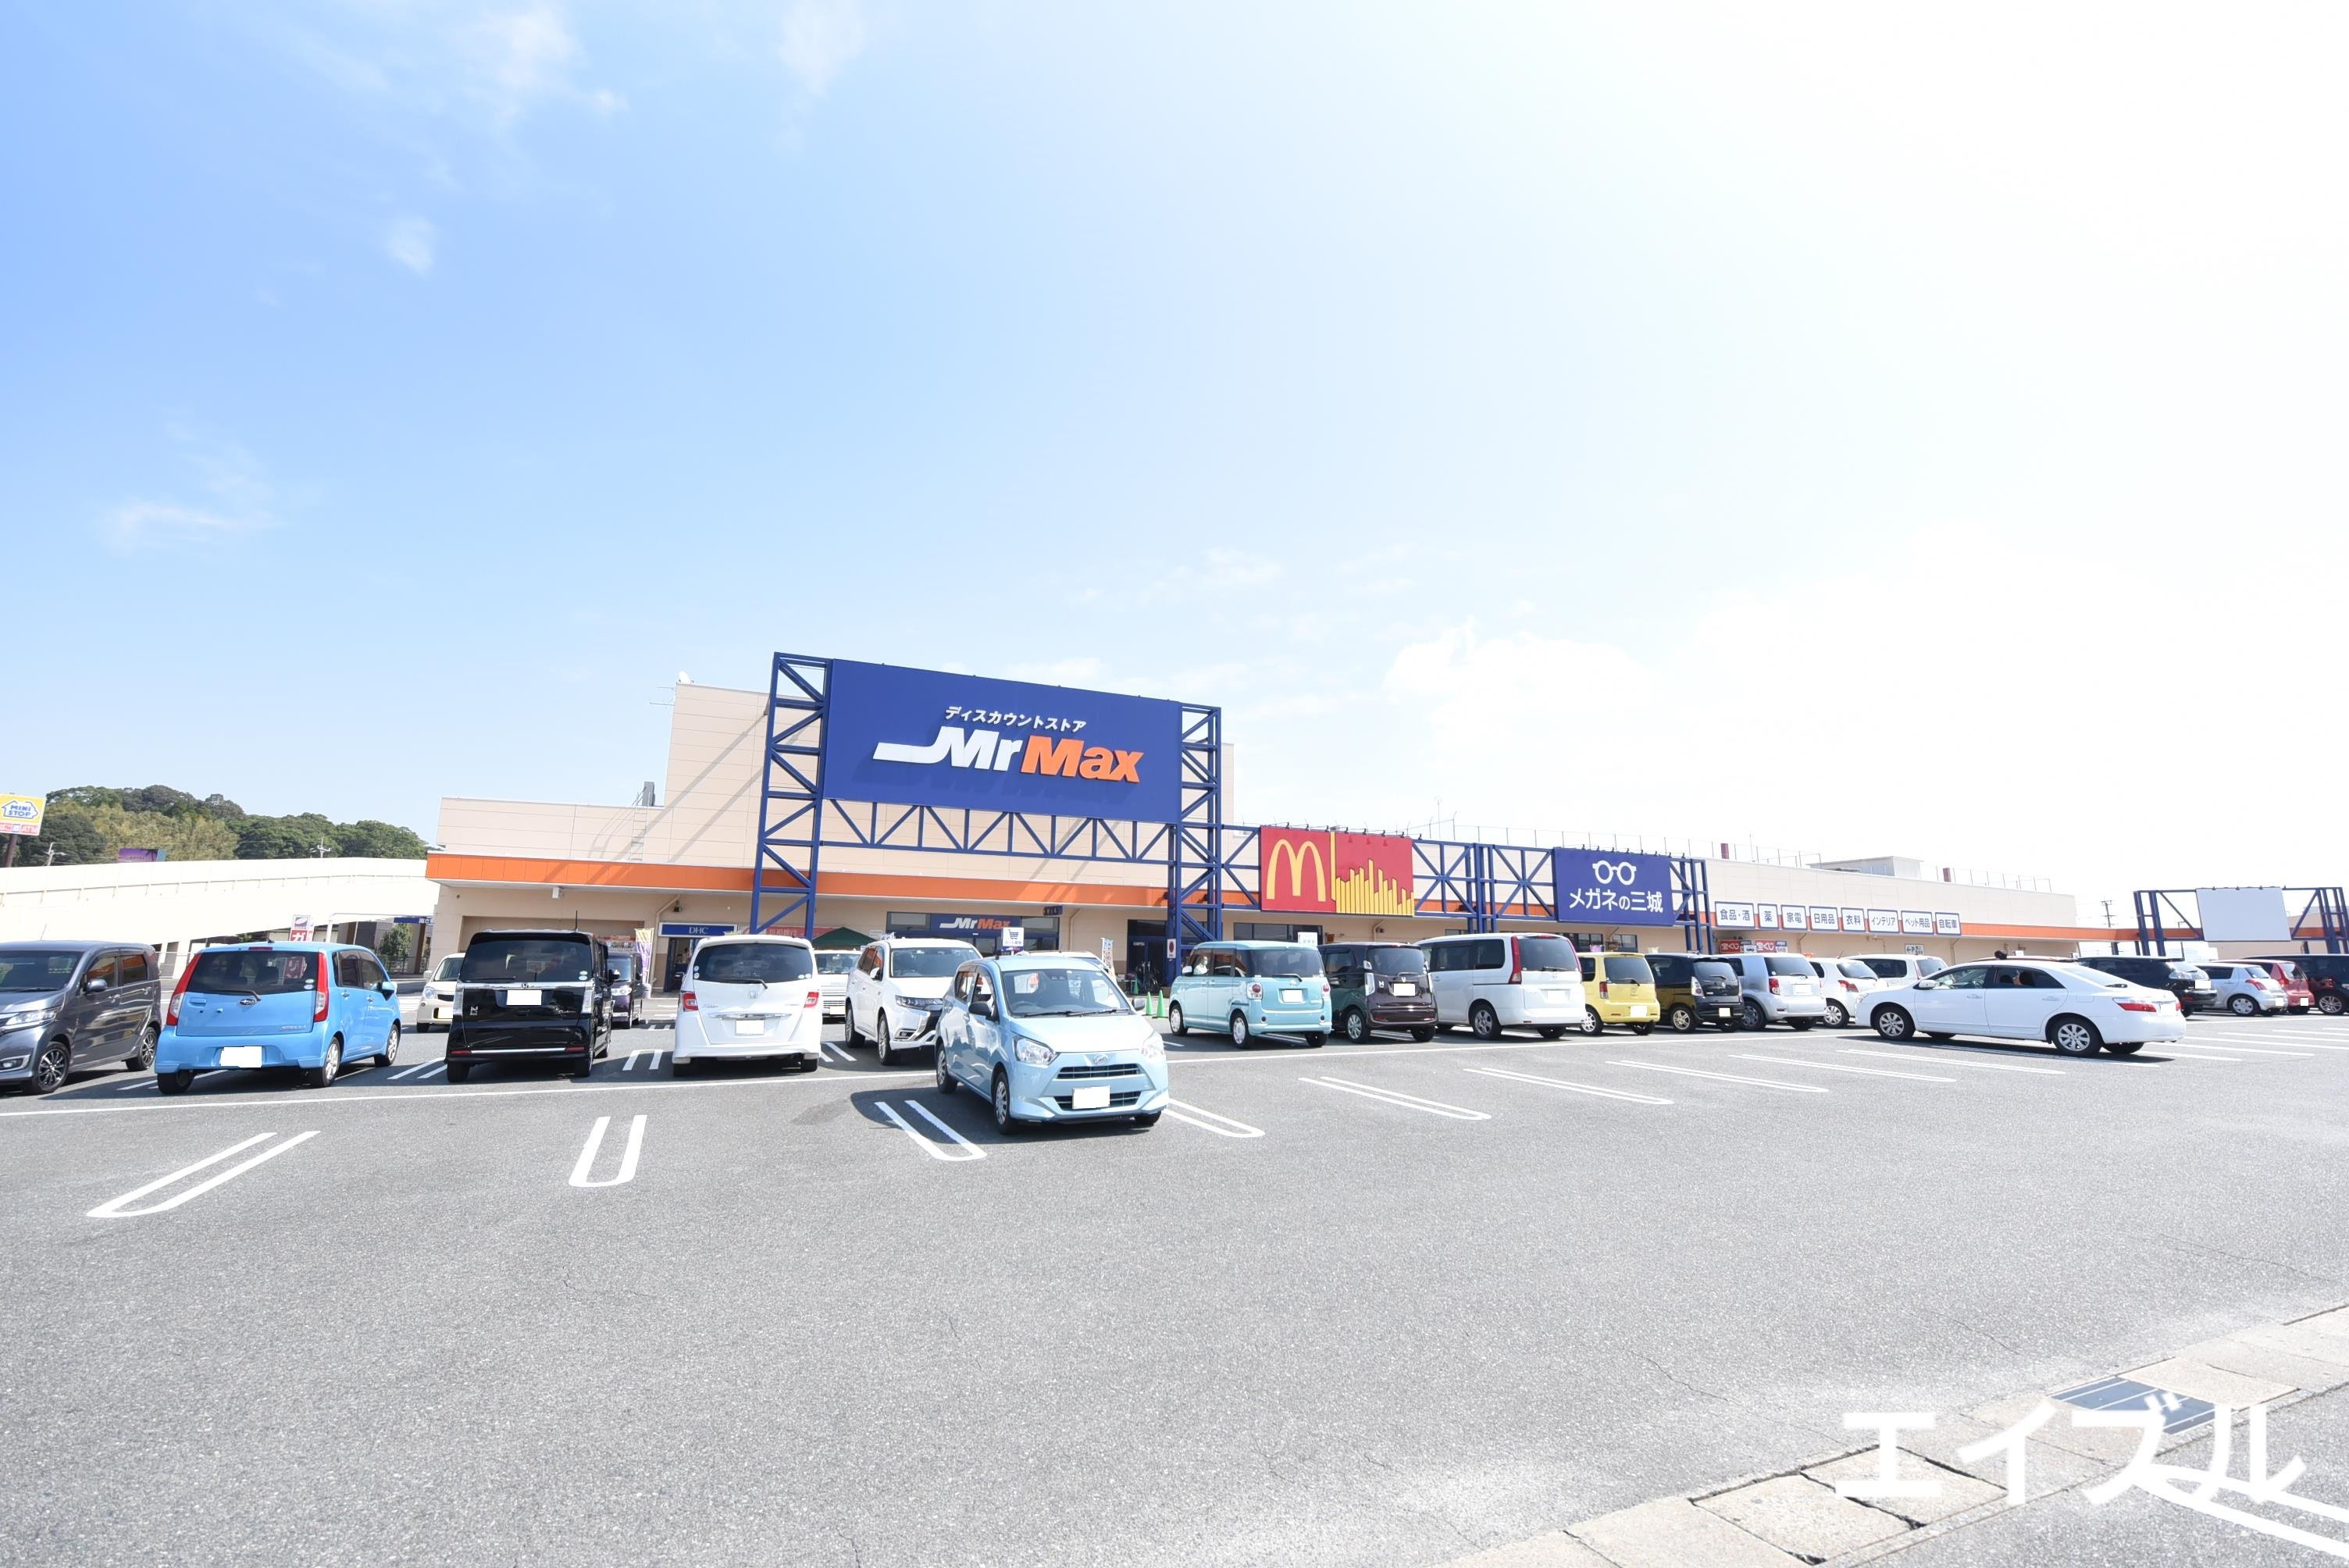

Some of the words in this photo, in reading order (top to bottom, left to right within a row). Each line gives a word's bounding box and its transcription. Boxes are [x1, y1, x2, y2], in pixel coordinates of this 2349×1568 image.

[945, 706, 1086, 733] ディスカウントストア
[1569, 888, 1663, 913] メガネの三城
[1720, 909, 1750, 921] 食品・酒
[1764, 911, 1773, 922] 薬
[1787, 913, 1802, 923] 家電
[1814, 914, 1834, 924] 日用品
[1846, 915, 1861, 925] 衣料
[1871, 917, 1895, 926] インテリア
[1905, 918, 1930, 928] ペット用品
[1939, 919, 1957, 928] 自転車
[1756, 942, 1774, 951] 宝くじ
